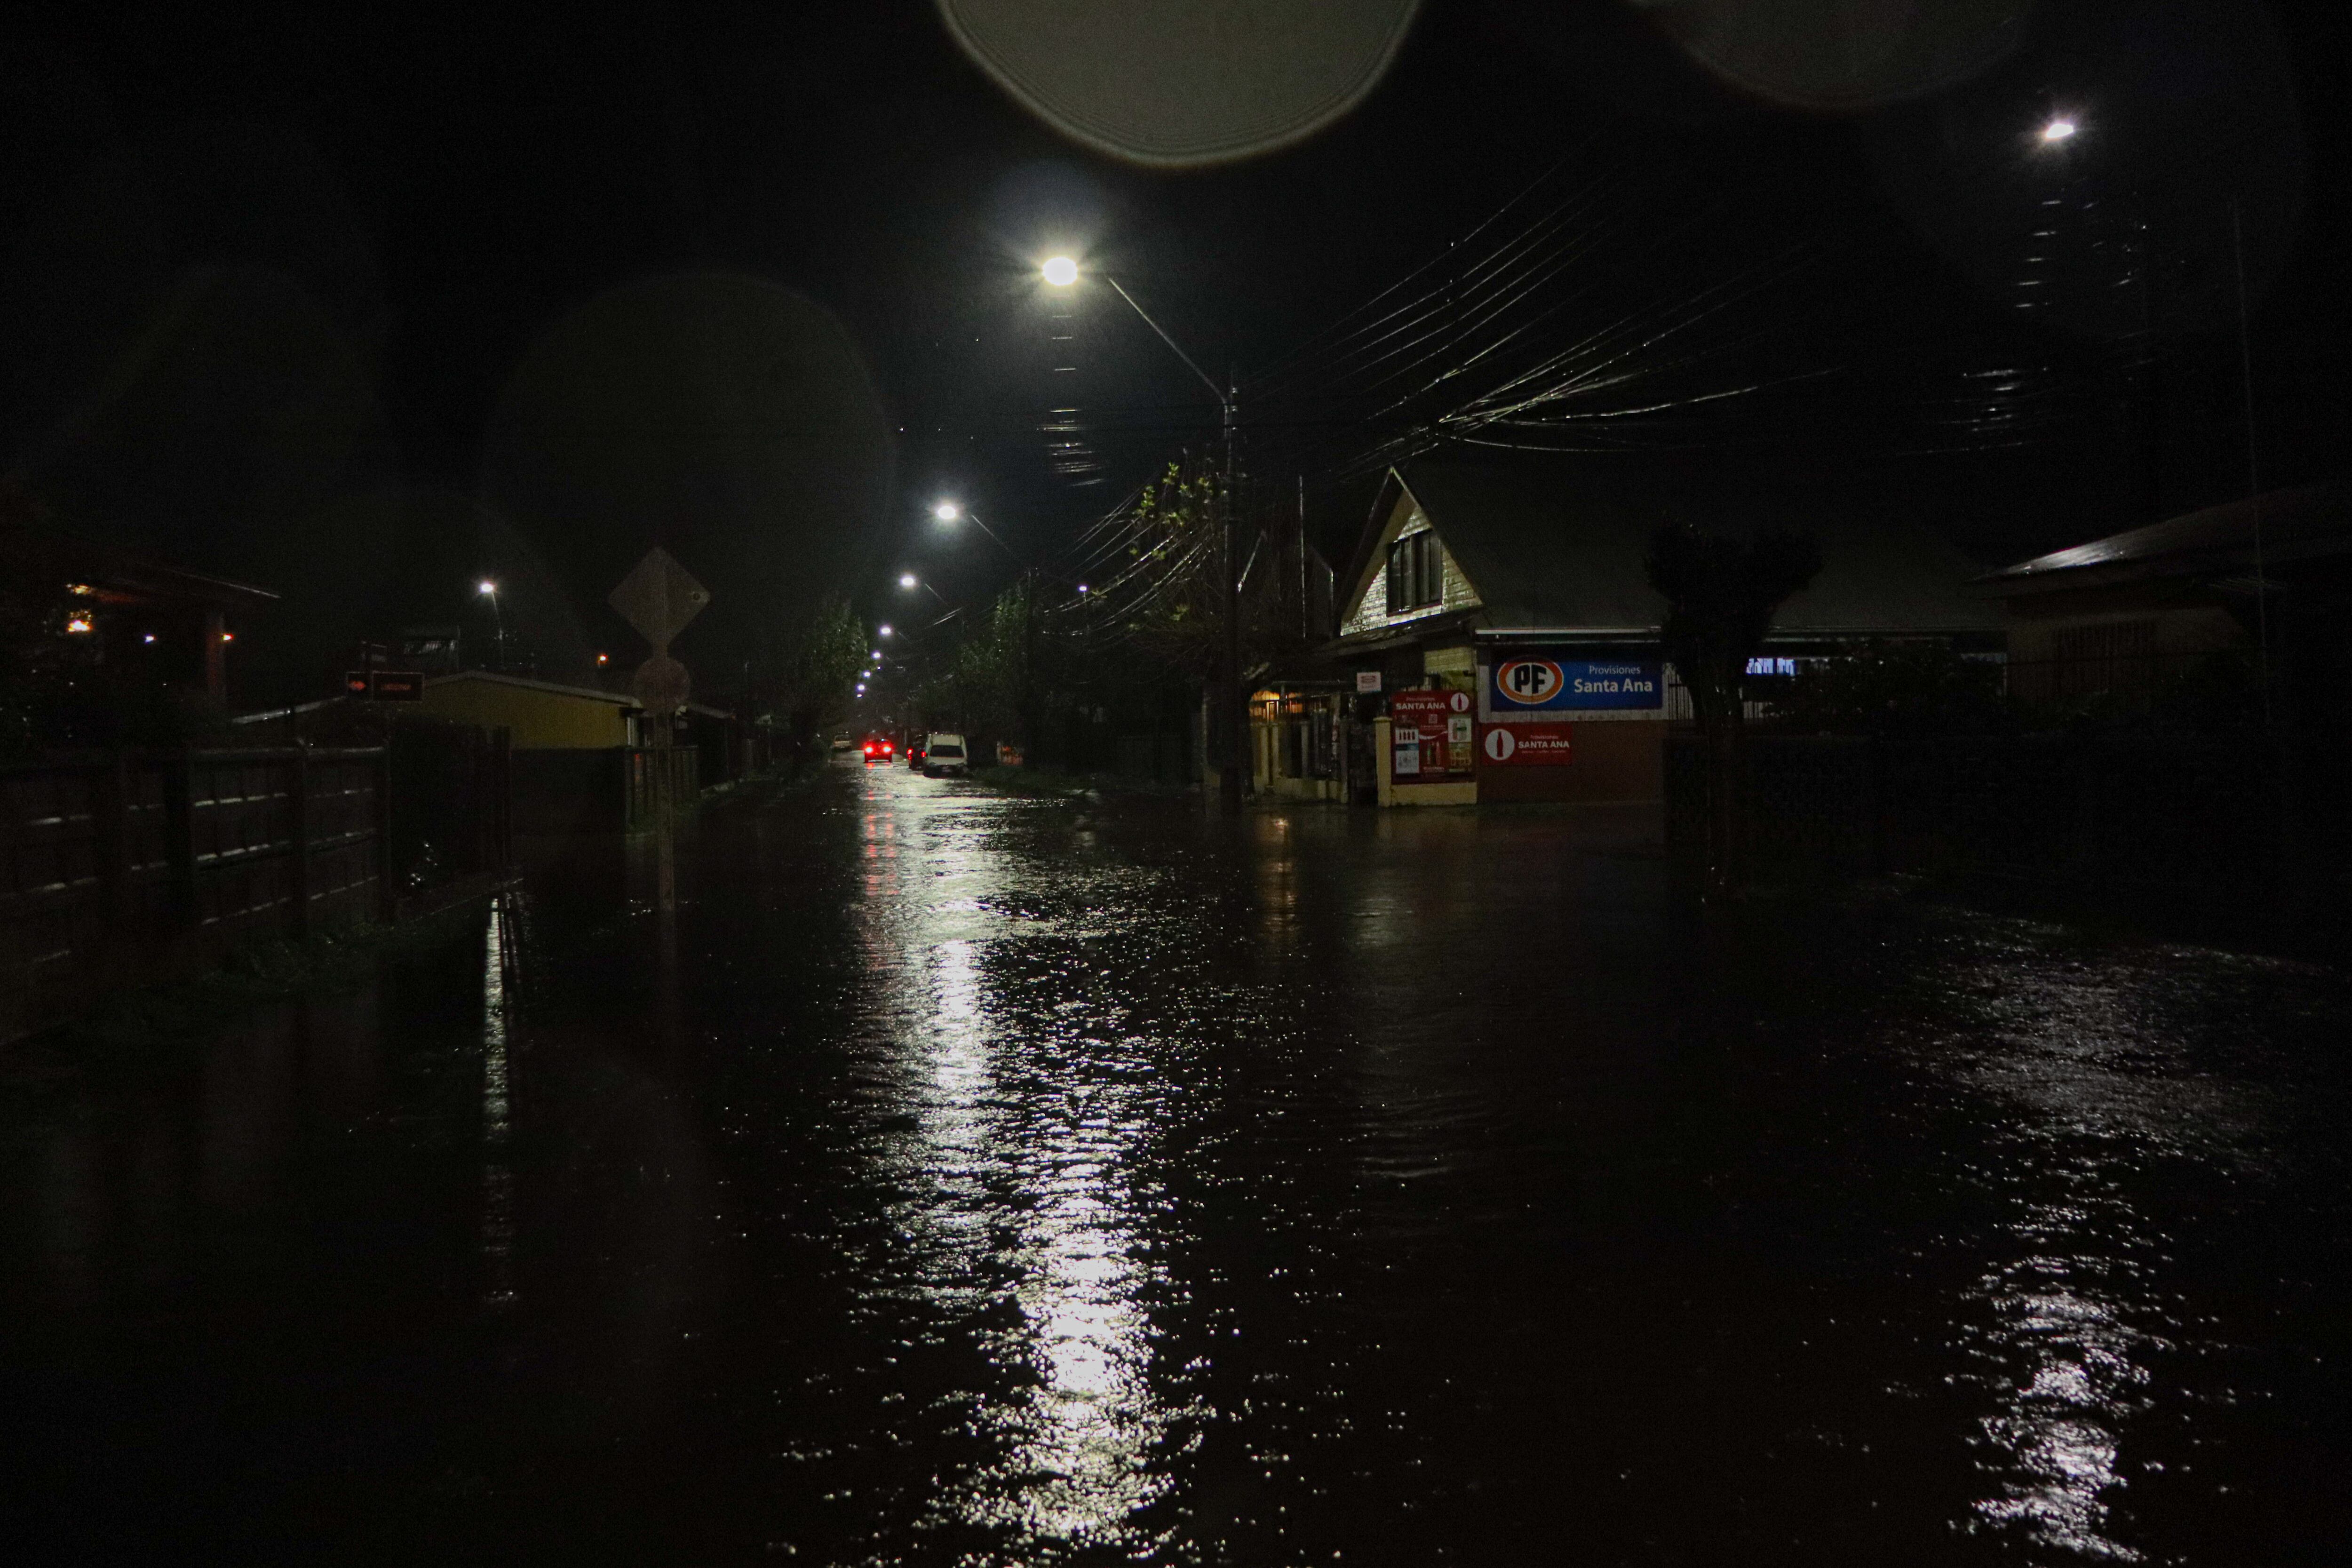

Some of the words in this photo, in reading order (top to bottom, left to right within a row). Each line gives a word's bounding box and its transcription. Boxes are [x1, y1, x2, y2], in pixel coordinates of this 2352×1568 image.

[1589, 665, 1641, 675] Provisiones
[1514, 664, 1546, 693] PF
[1573, 678, 1619, 693] Santa
[1622, 678, 1653, 692] Ana
